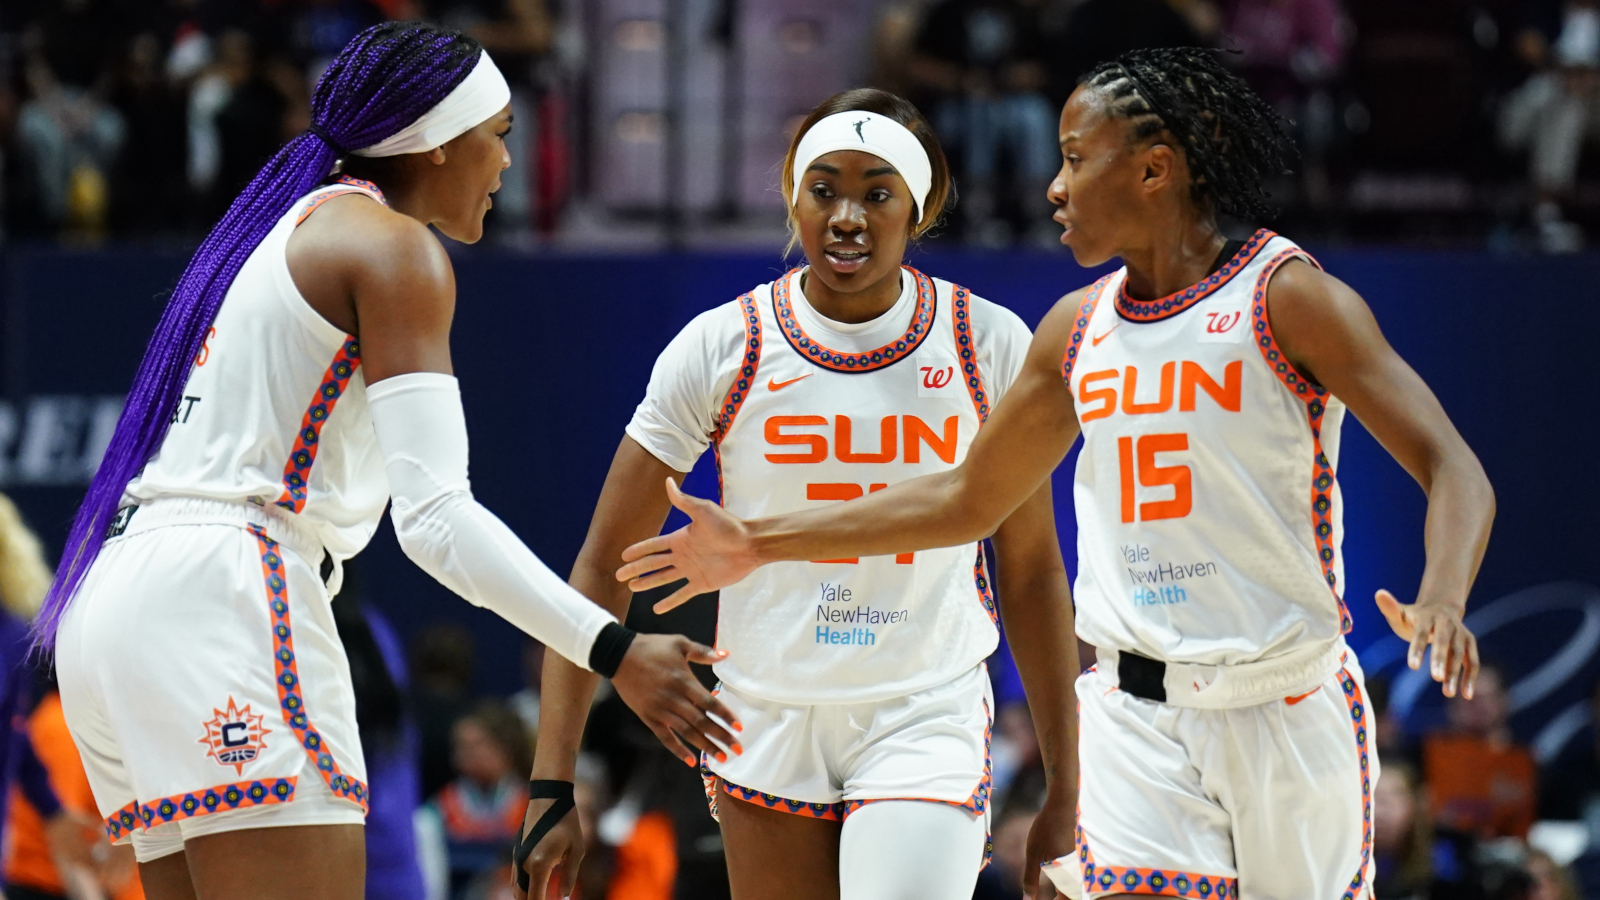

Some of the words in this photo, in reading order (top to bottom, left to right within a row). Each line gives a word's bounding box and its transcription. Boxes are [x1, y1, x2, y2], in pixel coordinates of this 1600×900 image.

[1078, 360, 1243, 424] SUN
[764, 414, 959, 464] SUN
[1118, 433, 1193, 524] 15
[1120, 544, 1150, 564] Yale
[1128, 561, 1218, 585] NewHaven
[820, 582, 852, 602] Yale
[1133, 585, 1187, 607] Health
[816, 605, 908, 624] NewHaven
[815, 625, 875, 646] Health
